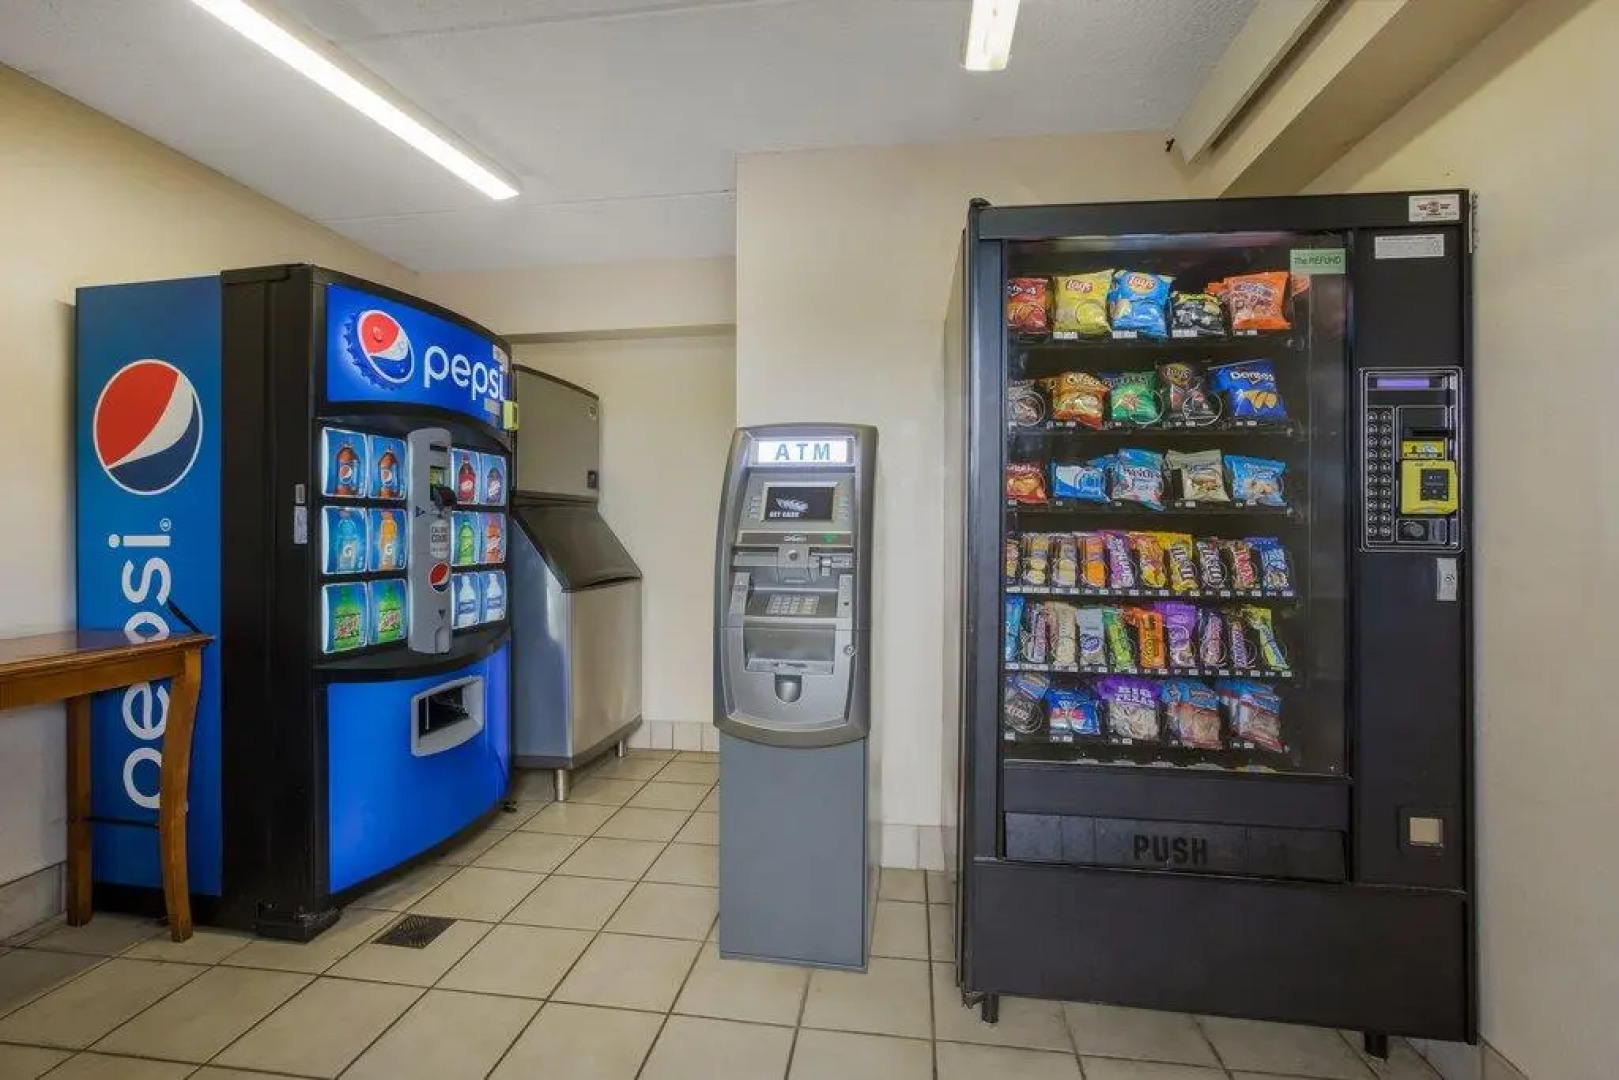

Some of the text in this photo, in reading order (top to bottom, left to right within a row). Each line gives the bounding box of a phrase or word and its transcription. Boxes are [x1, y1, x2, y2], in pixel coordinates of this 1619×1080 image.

[424, 345, 505, 402] pepsi
[775, 442, 831, 461] ATM
[1132, 833, 1209, 866] PUSH
